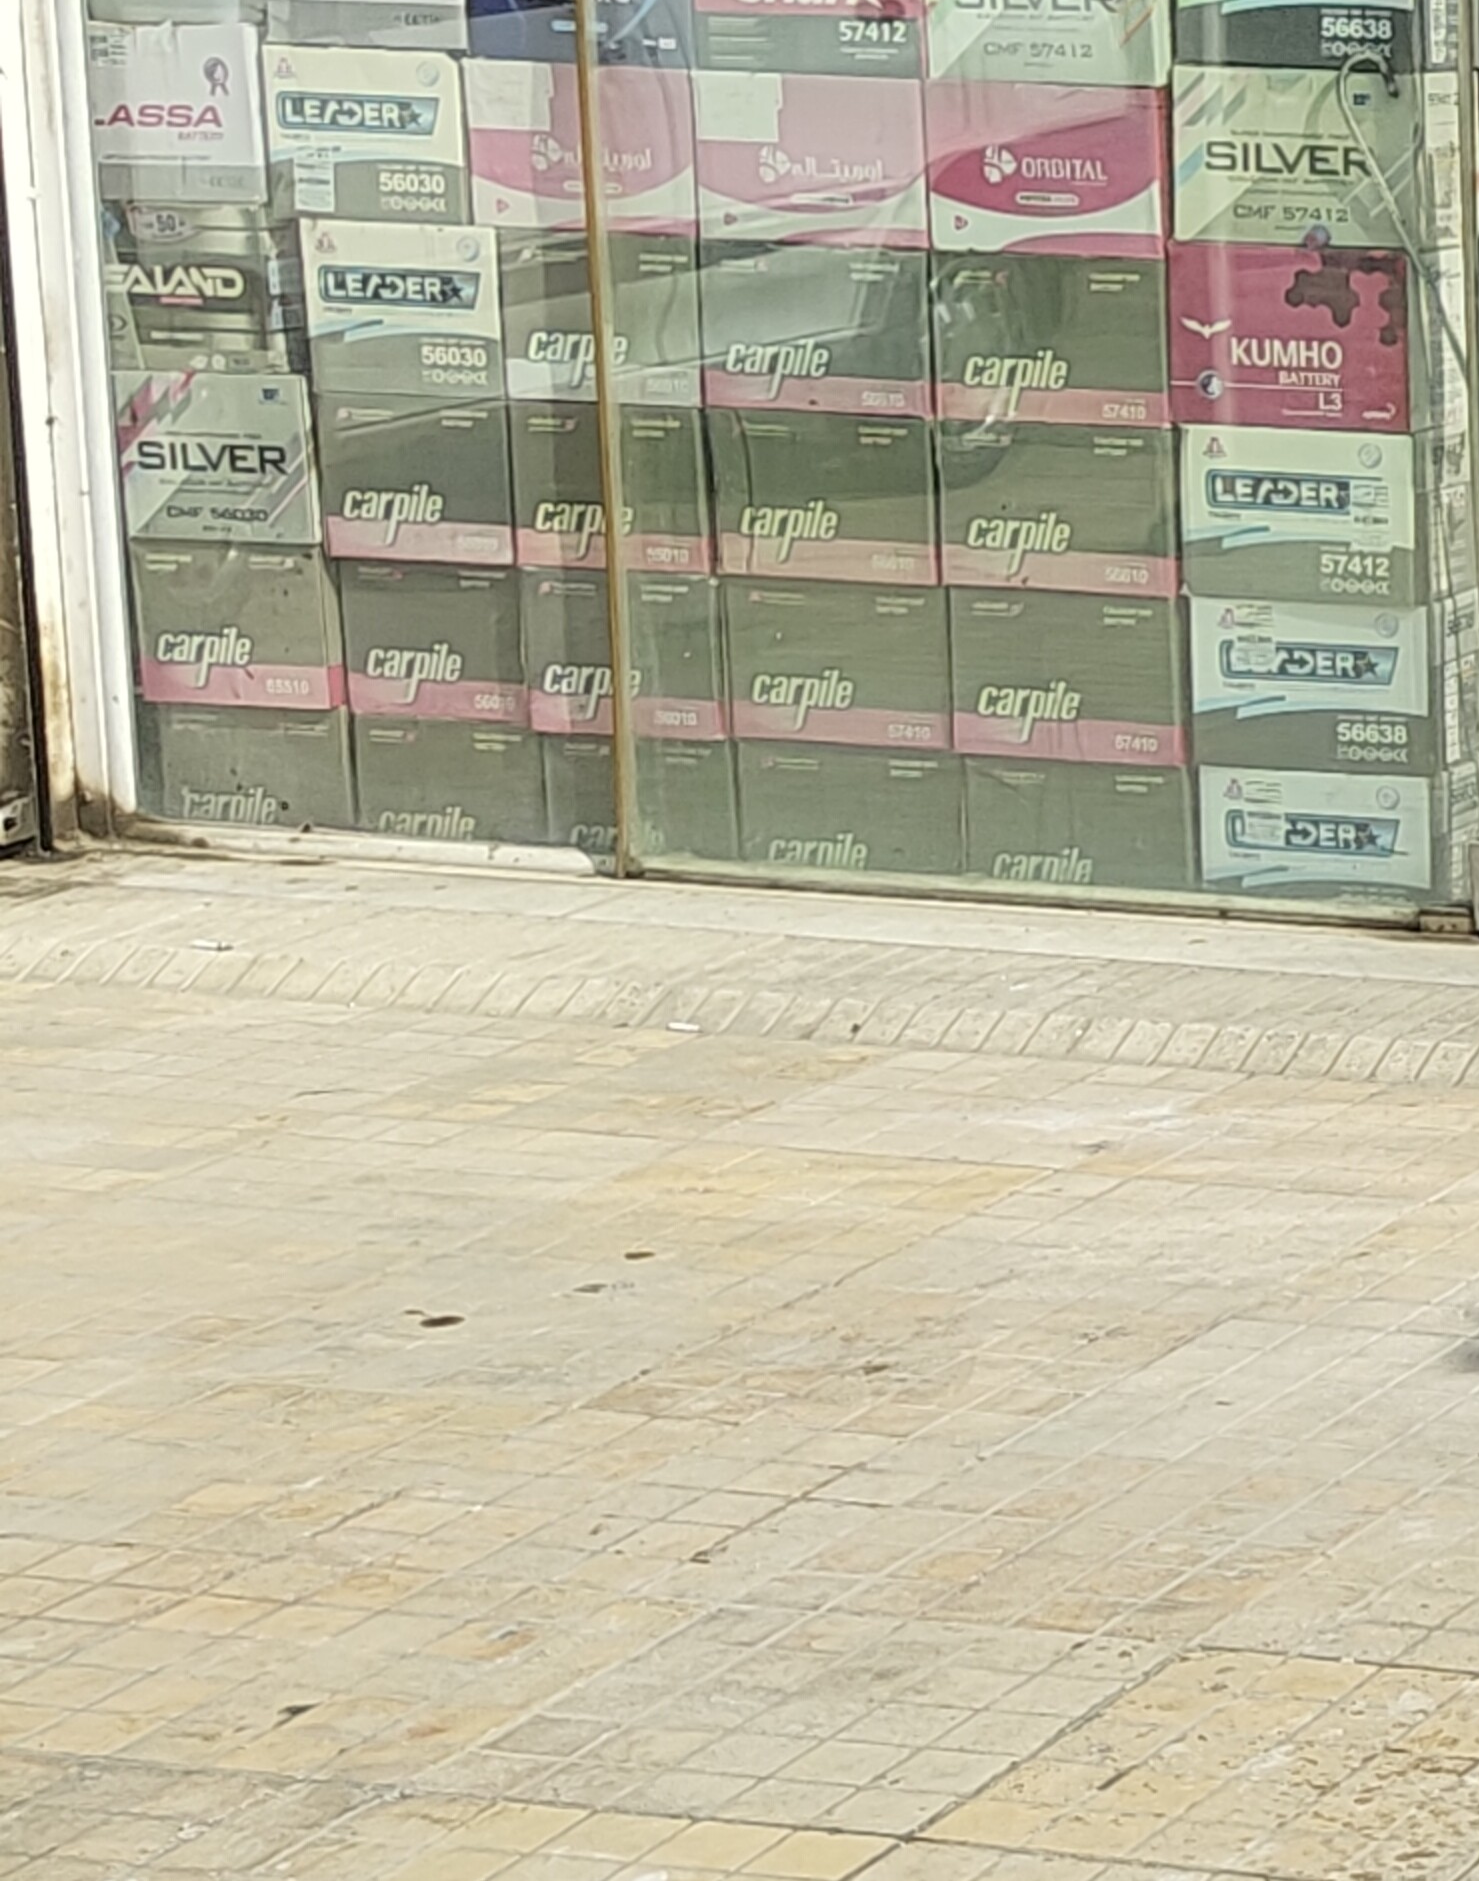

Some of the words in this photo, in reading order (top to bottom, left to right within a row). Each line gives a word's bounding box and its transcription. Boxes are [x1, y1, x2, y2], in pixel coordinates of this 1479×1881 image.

[839, 21, 907, 44] 57412
[1320, 18, 1393, 40] 56638
[94, 103, 223, 128] ASSA
[284, 97, 402, 129] LEADER
[1021, 157, 1108, 181] ORBITAL
[1204, 141, 1373, 177] SILVER
[379, 171, 447, 196] 56030
[1232, 204, 1276, 219] CMF
[1282, 205, 1349, 223] 57412
[326, 271, 445, 302] LEADER
[420, 345, 488, 368] 56030
[527, 329, 629, 388] carpe
[1230, 336, 1343, 369] KUMHO
[726, 339, 830, 400] carpile
[964, 350, 1069, 417] carpile
[1278, 370, 1341, 387] BATTERY
[1318, 392, 1343, 410] L3
[137, 440, 289, 475] SILVER
[1213, 475, 1340, 509] LEADER
[342, 483, 445, 546] carpile
[534, 500, 634, 559] carpe
[740, 498, 839, 561] carpile
[967, 512, 1071, 575] carpile
[1319, 554, 1390, 577] 57412
[156, 625, 253, 688] carpile
[366, 642, 463, 704] carpile
[752, 668, 854, 731] carpile
[977, 679, 1083, 744] carpile
[1336, 722, 1408, 744] 56638
